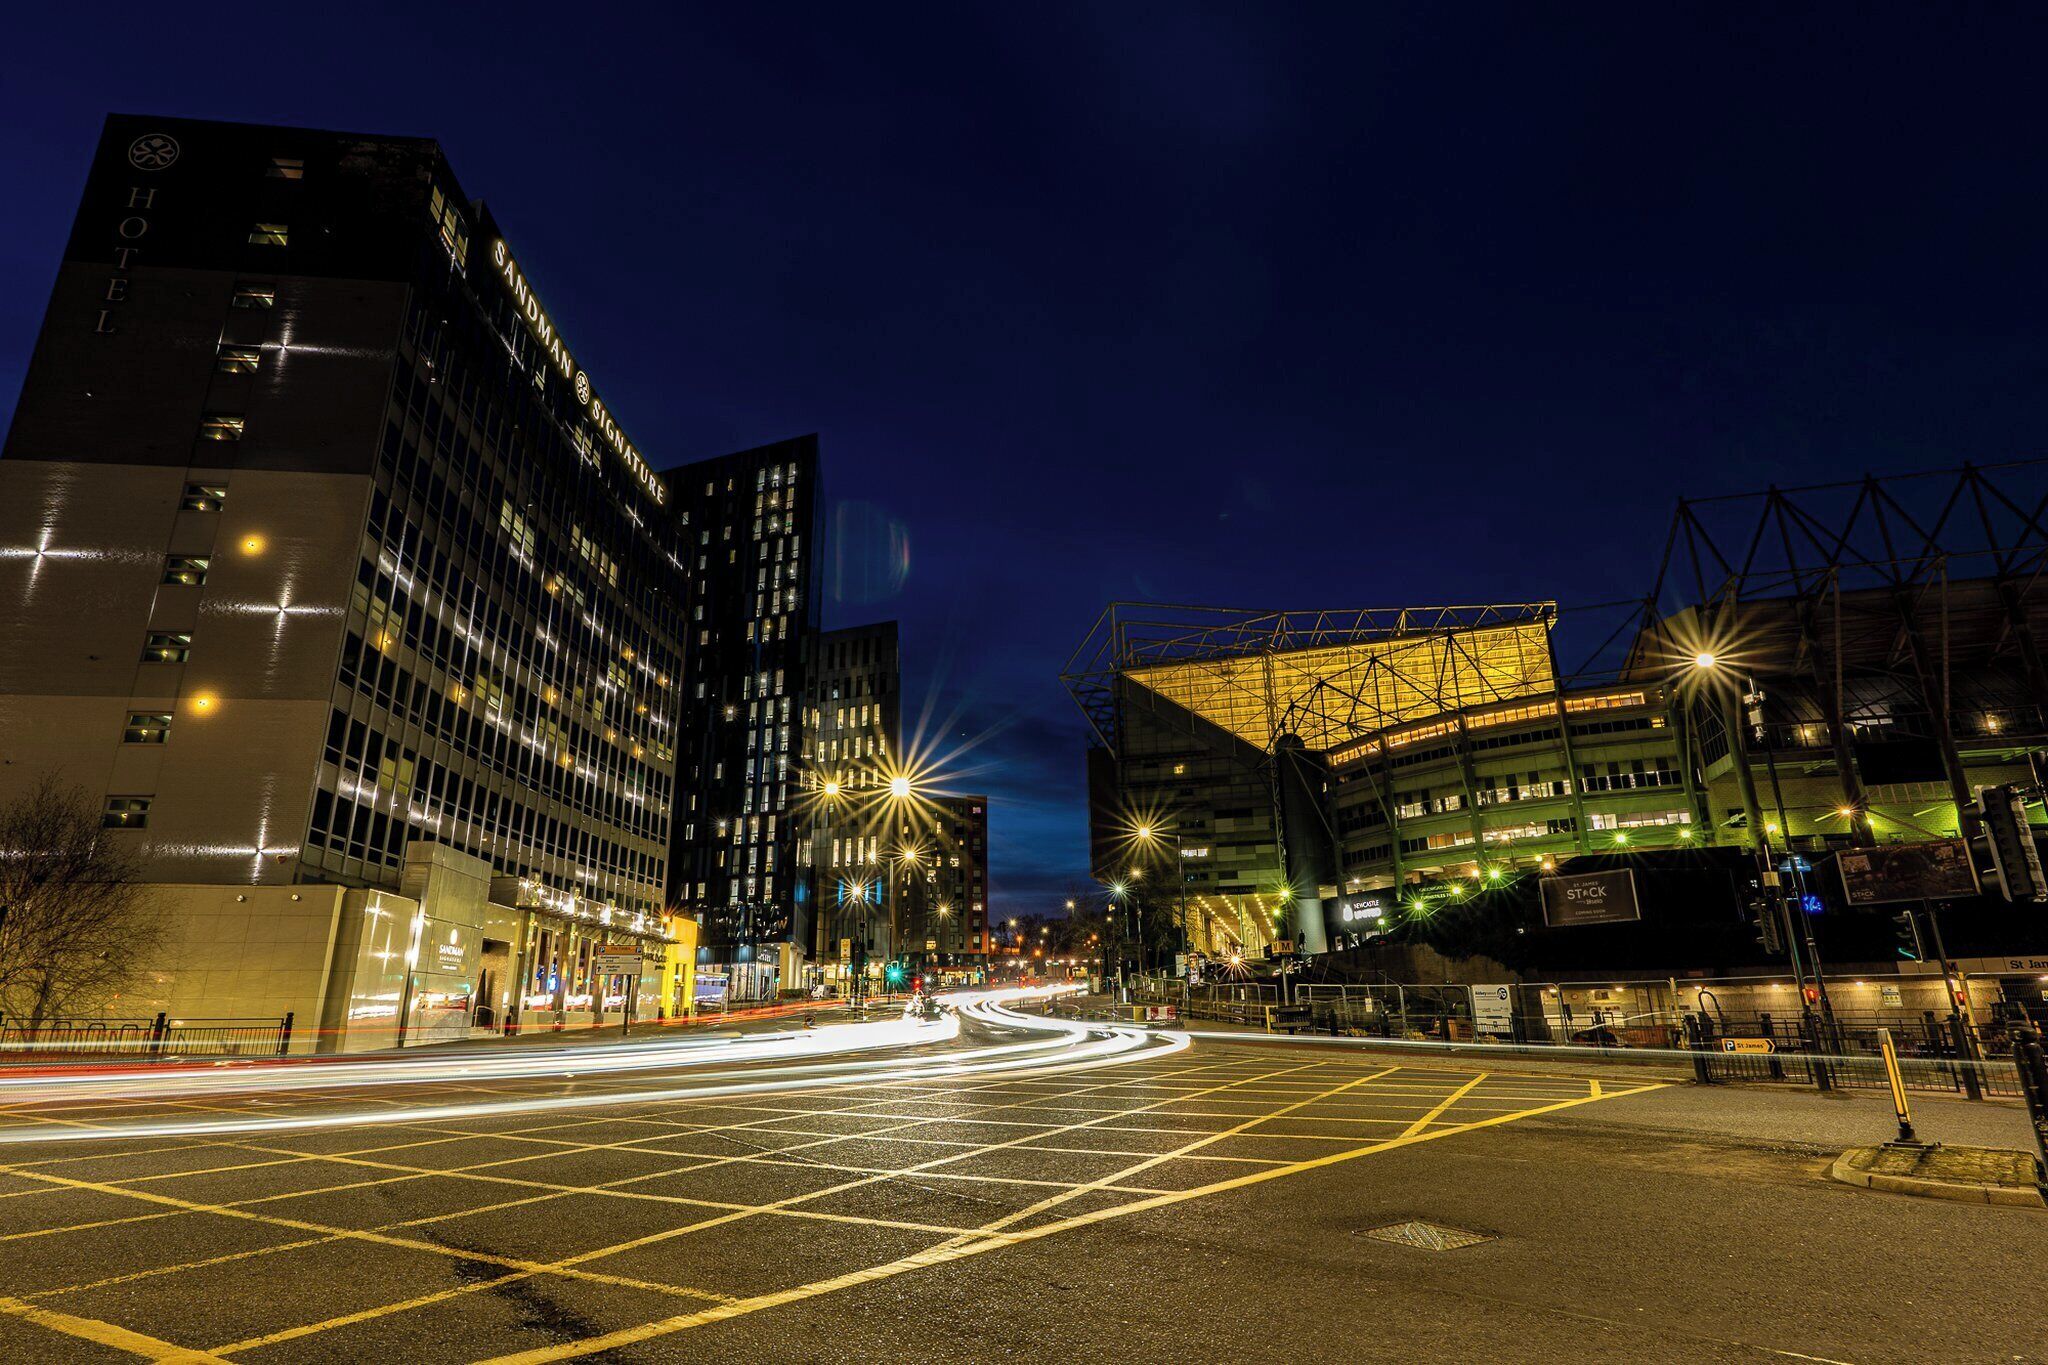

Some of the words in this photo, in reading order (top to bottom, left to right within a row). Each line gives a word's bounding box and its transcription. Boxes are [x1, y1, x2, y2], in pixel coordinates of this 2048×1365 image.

[95, 186, 157, 333] HOTEL
[494, 241, 572, 379] SANDMAN
[592, 400, 665, 505] SIGNATURE
[1353, 900, 1380, 909] NEWCASTLE
[1281, 942, 1291, 951] M
[2010, 960, 2024, 969] St
